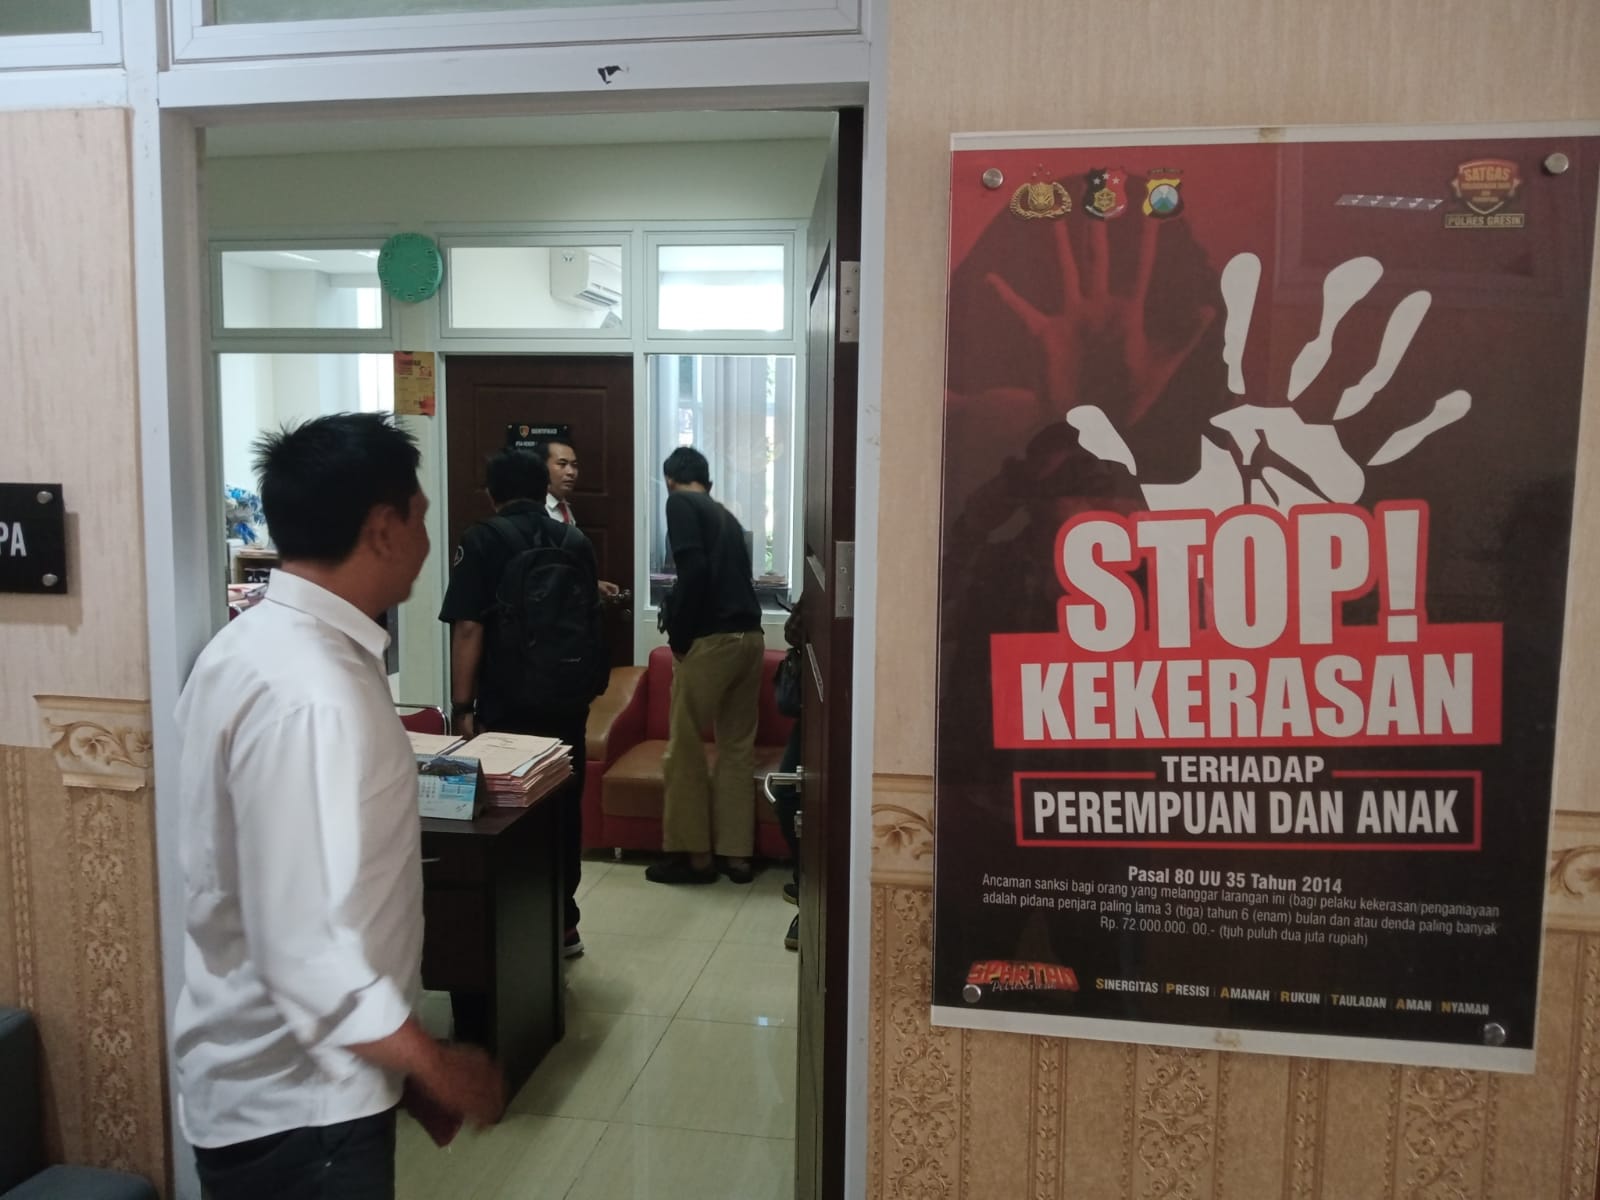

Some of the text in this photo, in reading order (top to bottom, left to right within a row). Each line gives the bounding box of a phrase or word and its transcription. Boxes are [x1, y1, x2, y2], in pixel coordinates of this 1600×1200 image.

[1464, 166, 1511, 181] SATGAS
[1063, 509, 1420, 653] STOP!
[1020, 653, 1473, 740] KEKERASAN
[1161, 755, 1325, 784] TERHADAP
[1033, 789, 1459, 834] PEREMPUAN DAN ANAK
[982, 873, 1031, 888] Ancaman
[1034, 878, 1069, 891] sanksi
[1071, 879, 1095, 895] bagi
[1097, 883, 1128, 898] orang
[1131, 885, 1157, 898] yang
[1161, 886, 1219, 902] melanggar
[1221, 889, 1269, 905] larangan
[1272, 892, 1285, 904] ini
[1289, 893, 1317, 909] (bagi
[1320, 895, 1357, 909] pelaku
[1128, 865, 1342, 894] Pasal 80 UU 35 Tahun 2014
[982, 892, 1497, 936] adalah pidana penjara paling lama 3 (tiga) tahun 6 (enam) bulan dan atau denda paling banyak
[1100, 915, 1119, 931] Rp.
[1247, 928, 1278, 941] puluh
[1281, 928, 1302, 941] dua
[1304, 931, 1326, 945] juta
[1328, 932, 1368, 947] rupiah)
[966, 959, 1079, 992] SPARTAN
[1095, 978, 1490, 1016] SINERGITAS PRESISI AMANAH RUKUN TAULADAN AMAN NYAMAN
